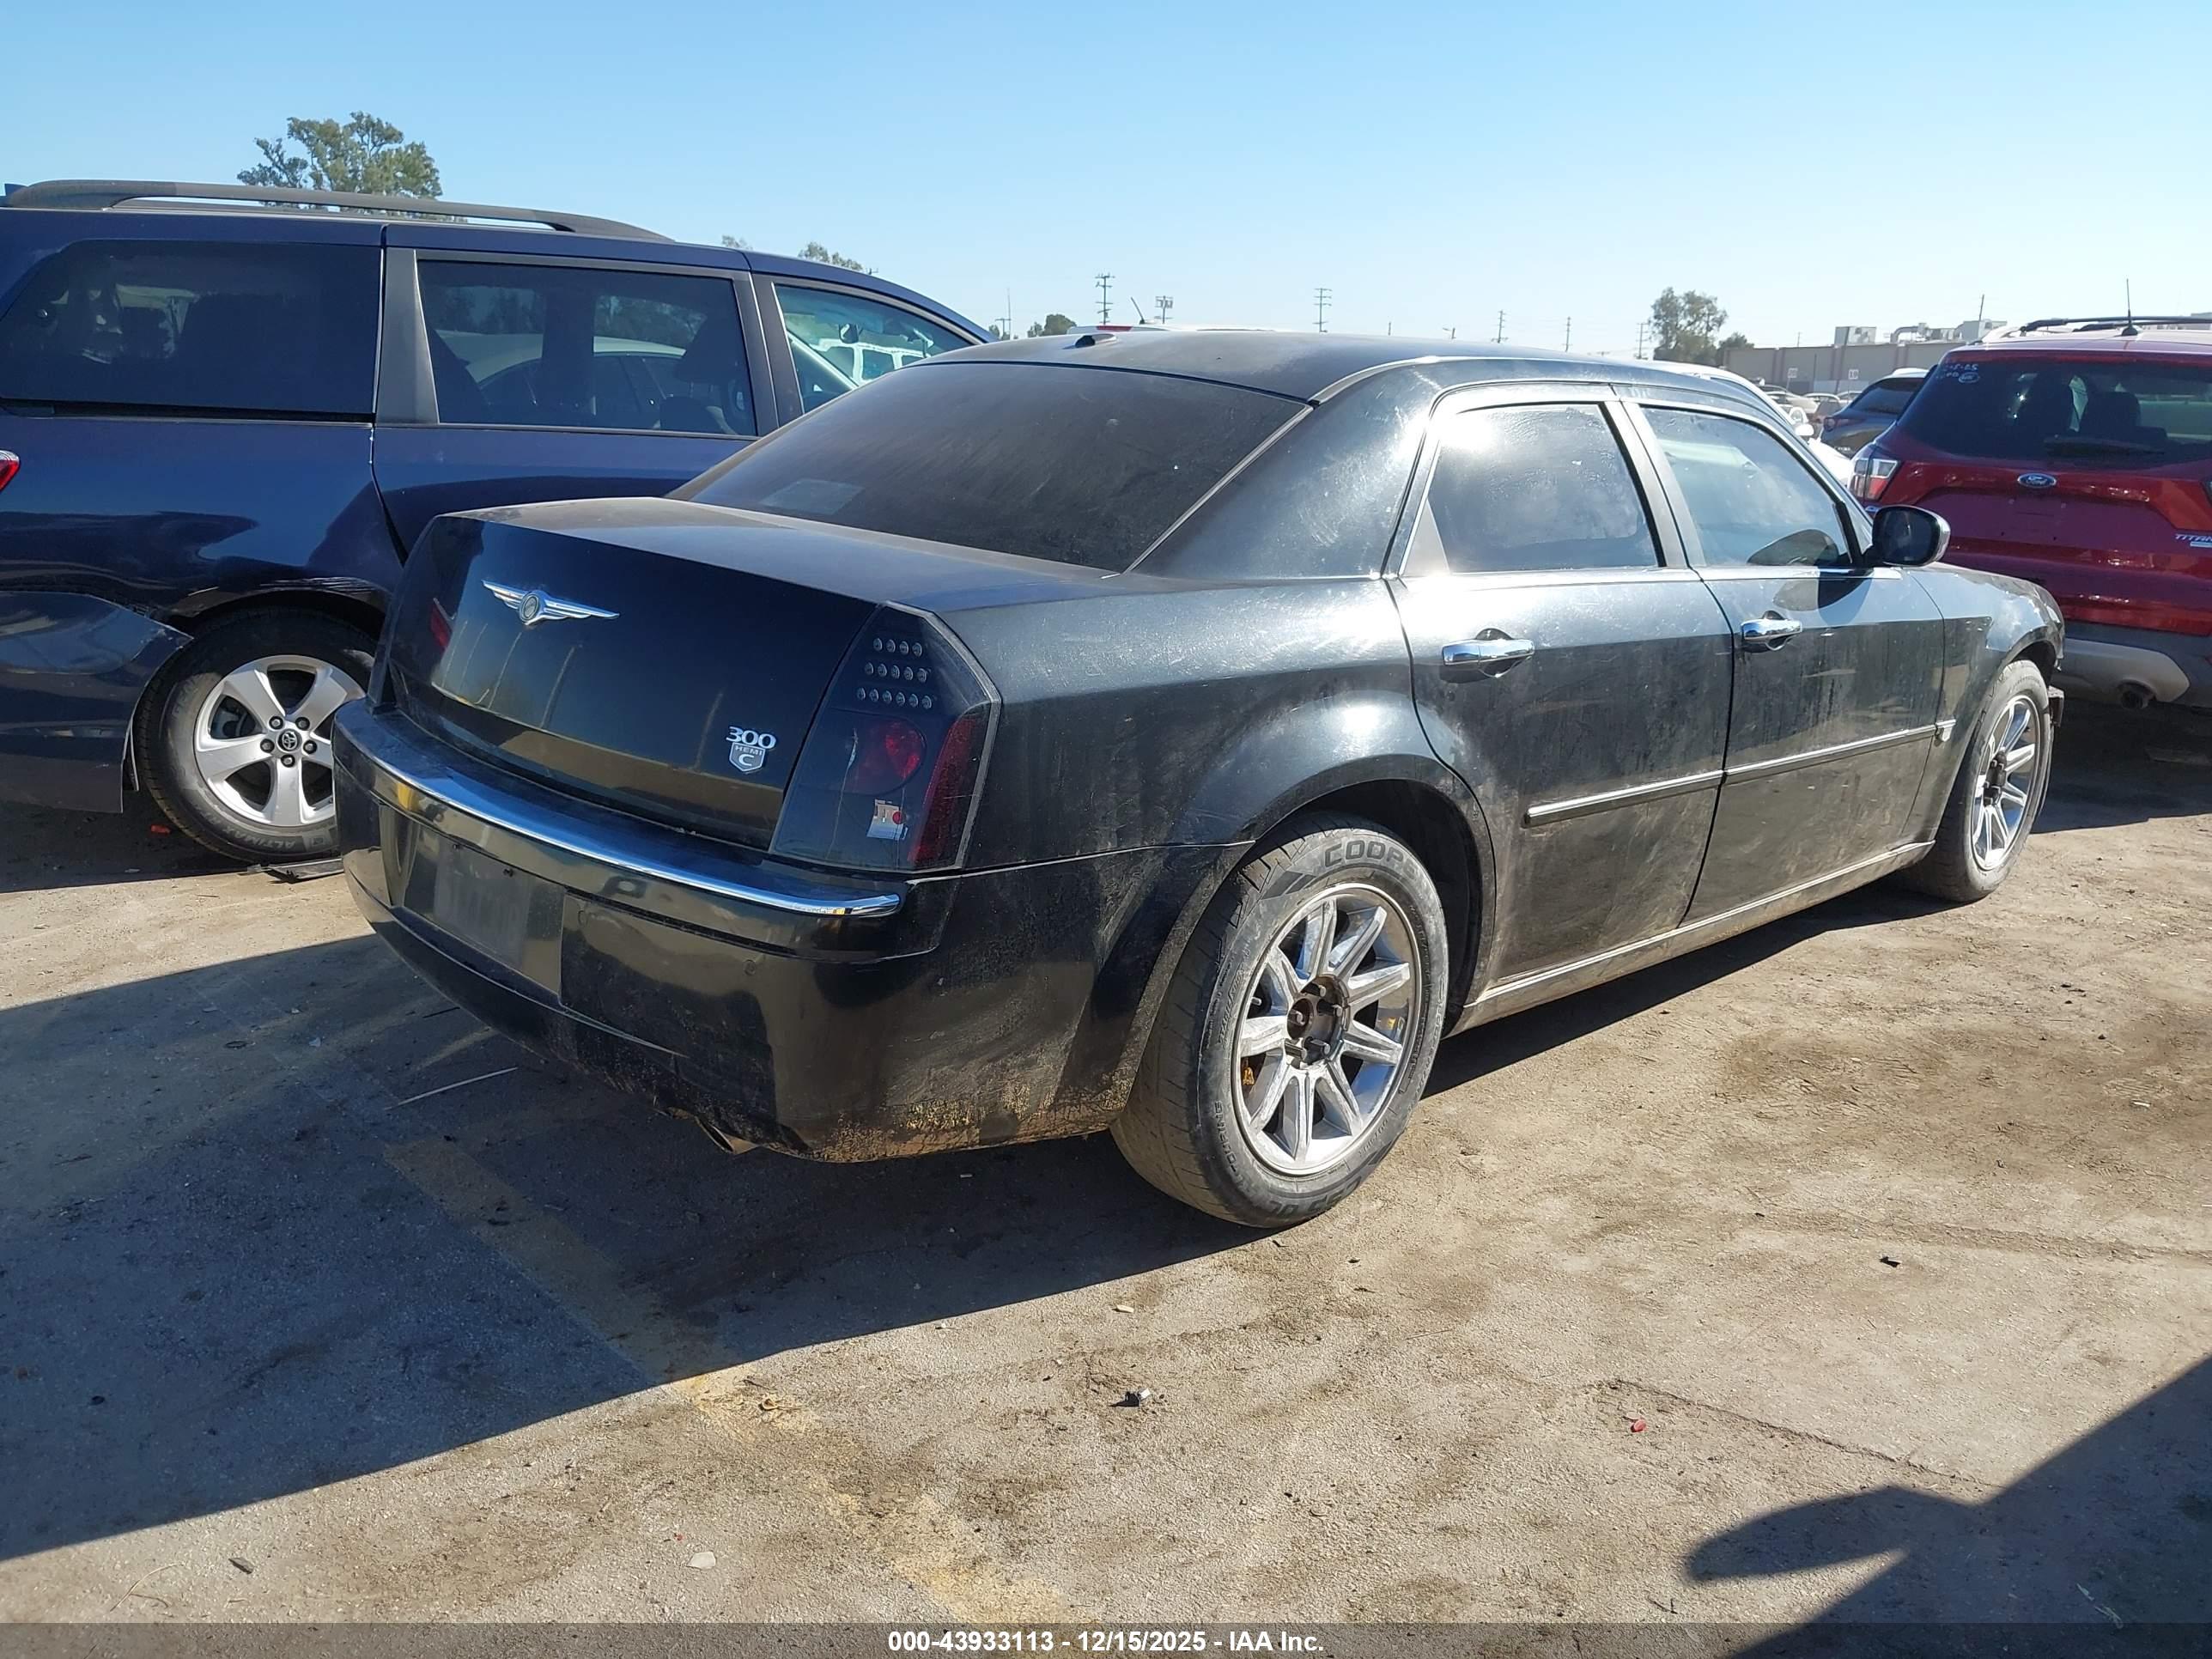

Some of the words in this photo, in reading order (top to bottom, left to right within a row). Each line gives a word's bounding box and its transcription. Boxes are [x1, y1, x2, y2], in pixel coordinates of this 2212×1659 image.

[726, 726, 777, 749] 300
[734, 744, 763, 756] HEMI
[738, 753, 755, 767] C
[222, 825, 296, 849] ALTIMAX
